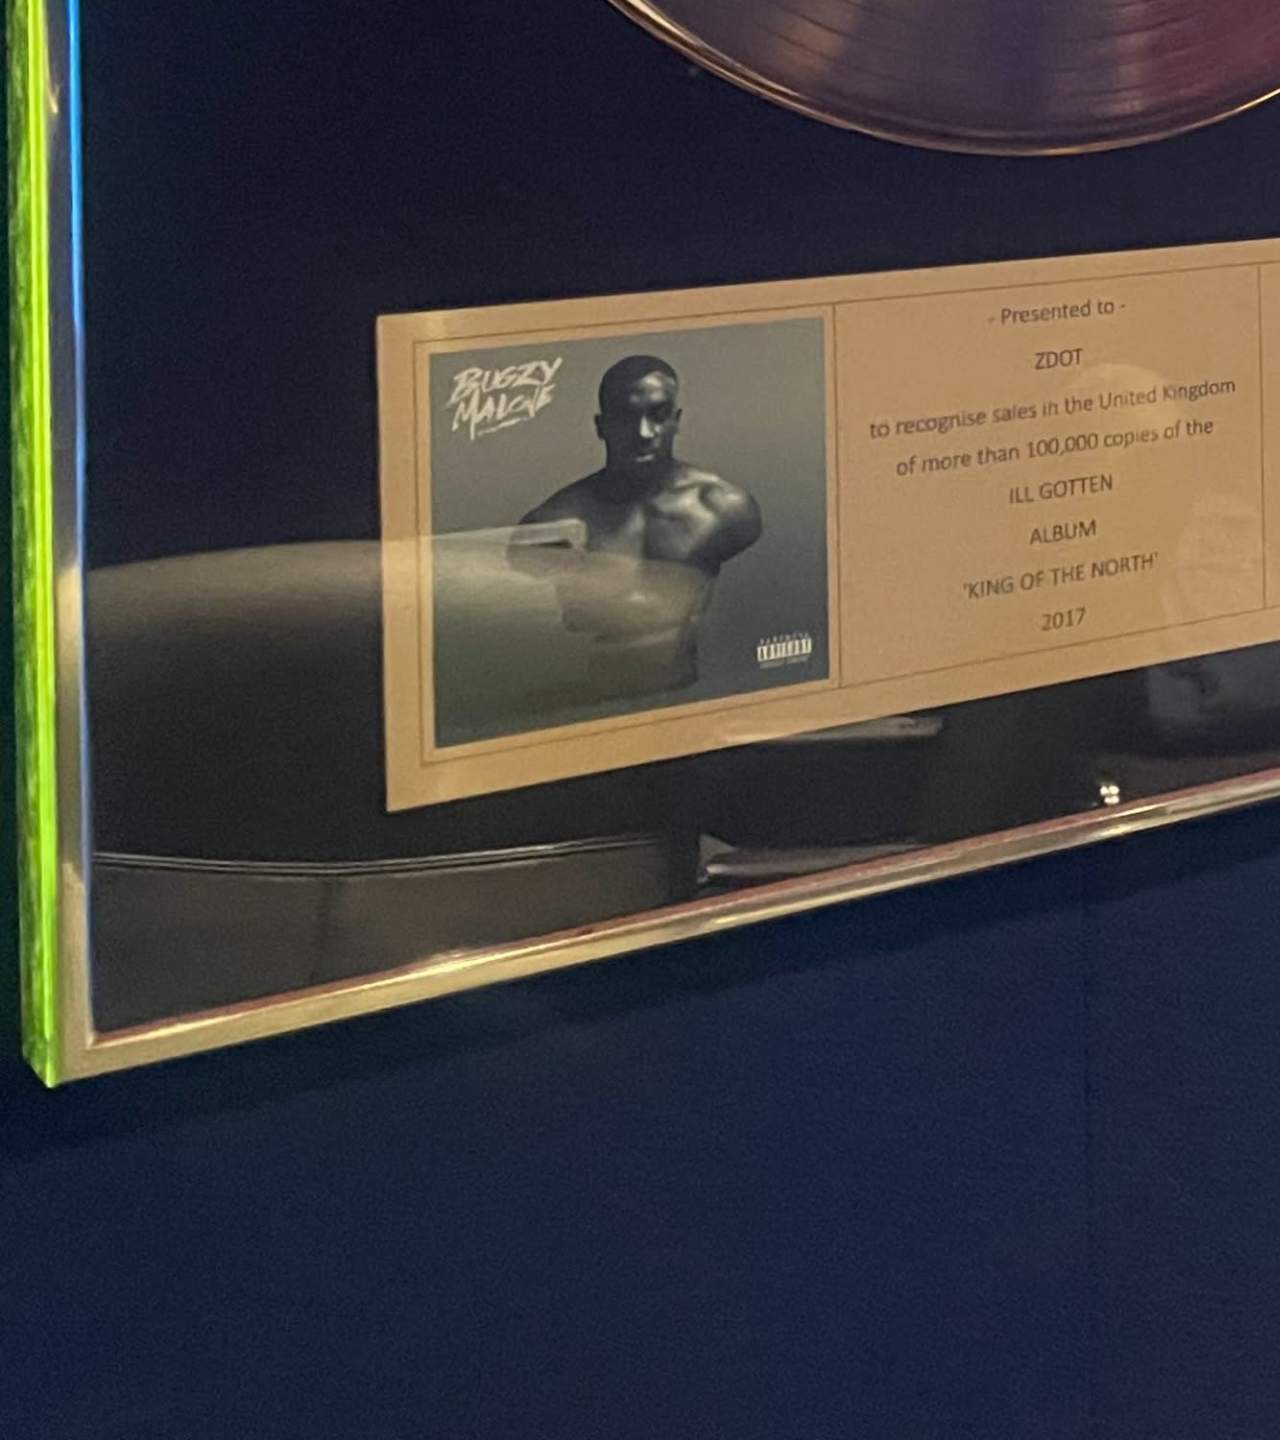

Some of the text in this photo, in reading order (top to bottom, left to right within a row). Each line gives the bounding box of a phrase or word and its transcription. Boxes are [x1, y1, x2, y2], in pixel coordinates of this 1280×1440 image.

[1000, 303, 1091, 325] Presented
[1097, 300, 1115, 315] to
[1034, 348, 1084, 371] ZDOT
[444, 357, 563, 411] BUGZY
[451, 384, 556, 441] MALONE
[869, 378, 1236, 440] to recognise sales in the United Kingdom
[895, 418, 1214, 477] of more than 100,000 copies of the
[1008, 473, 1114, 505] ILL GOTTEN
[1029, 519, 1097, 545] ALBUM
[963, 551, 1159, 600] 'KING OF THE NORTH'
[1041, 607, 1087, 632] 2017
